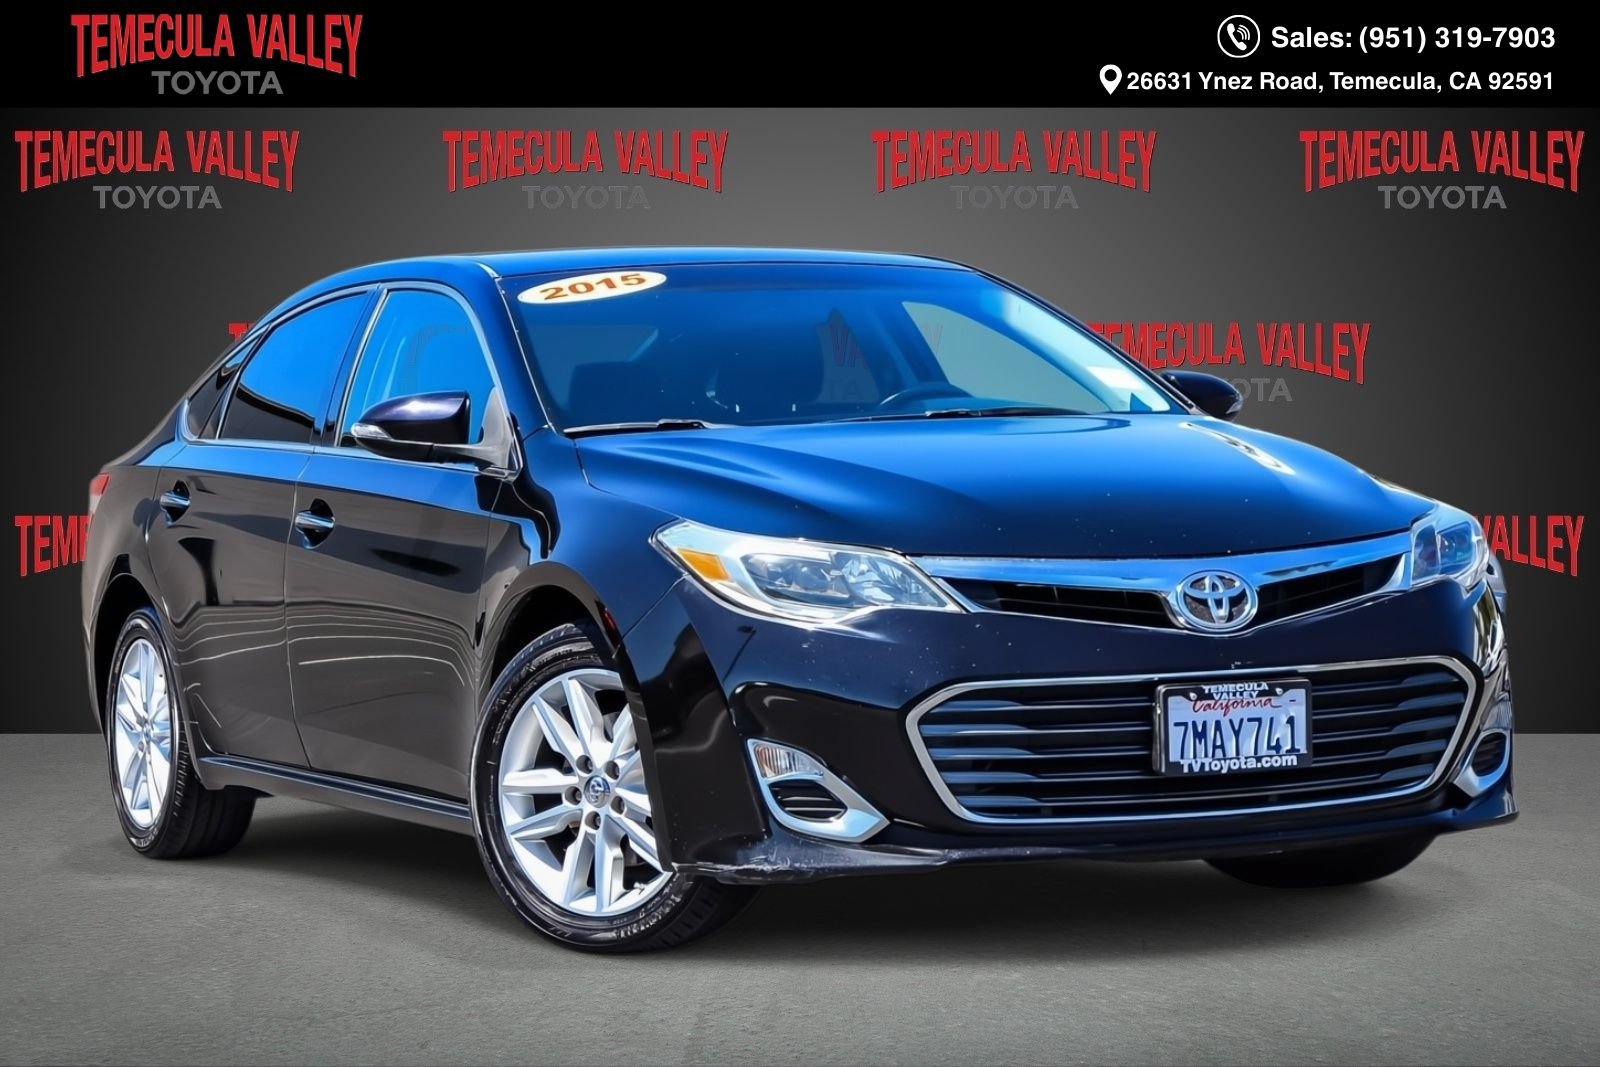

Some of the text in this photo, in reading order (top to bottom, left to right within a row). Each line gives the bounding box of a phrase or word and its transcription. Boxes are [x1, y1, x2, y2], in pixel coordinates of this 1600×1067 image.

[14, 129, 299, 193] TEMECULA VALLEY
[442, 129, 727, 193] TEMECULA VALLEY
[871, 129, 1156, 193] TEMECULA VALLEY
[1299, 129, 1584, 193] TEMECULA VALLEY
[93, 185, 222, 209] TOYOTA
[521, 185, 650, 209] TOYOTA
[949, 185, 1078, 209] TOYOTA
[1378, 185, 1507, 209] TOYOTA
[540, 273, 647, 300] 2015
[1257, 322, 1370, 384] VALLEY
[1203, 682, 1269, 694] TEMECULA
[1213, 690, 1259, 700] VALLEY
[1192, 697, 1281, 717] California
[1173, 715, 1300, 760] 7MAY741
[1180, 754, 1298, 774] TVToyota.com
